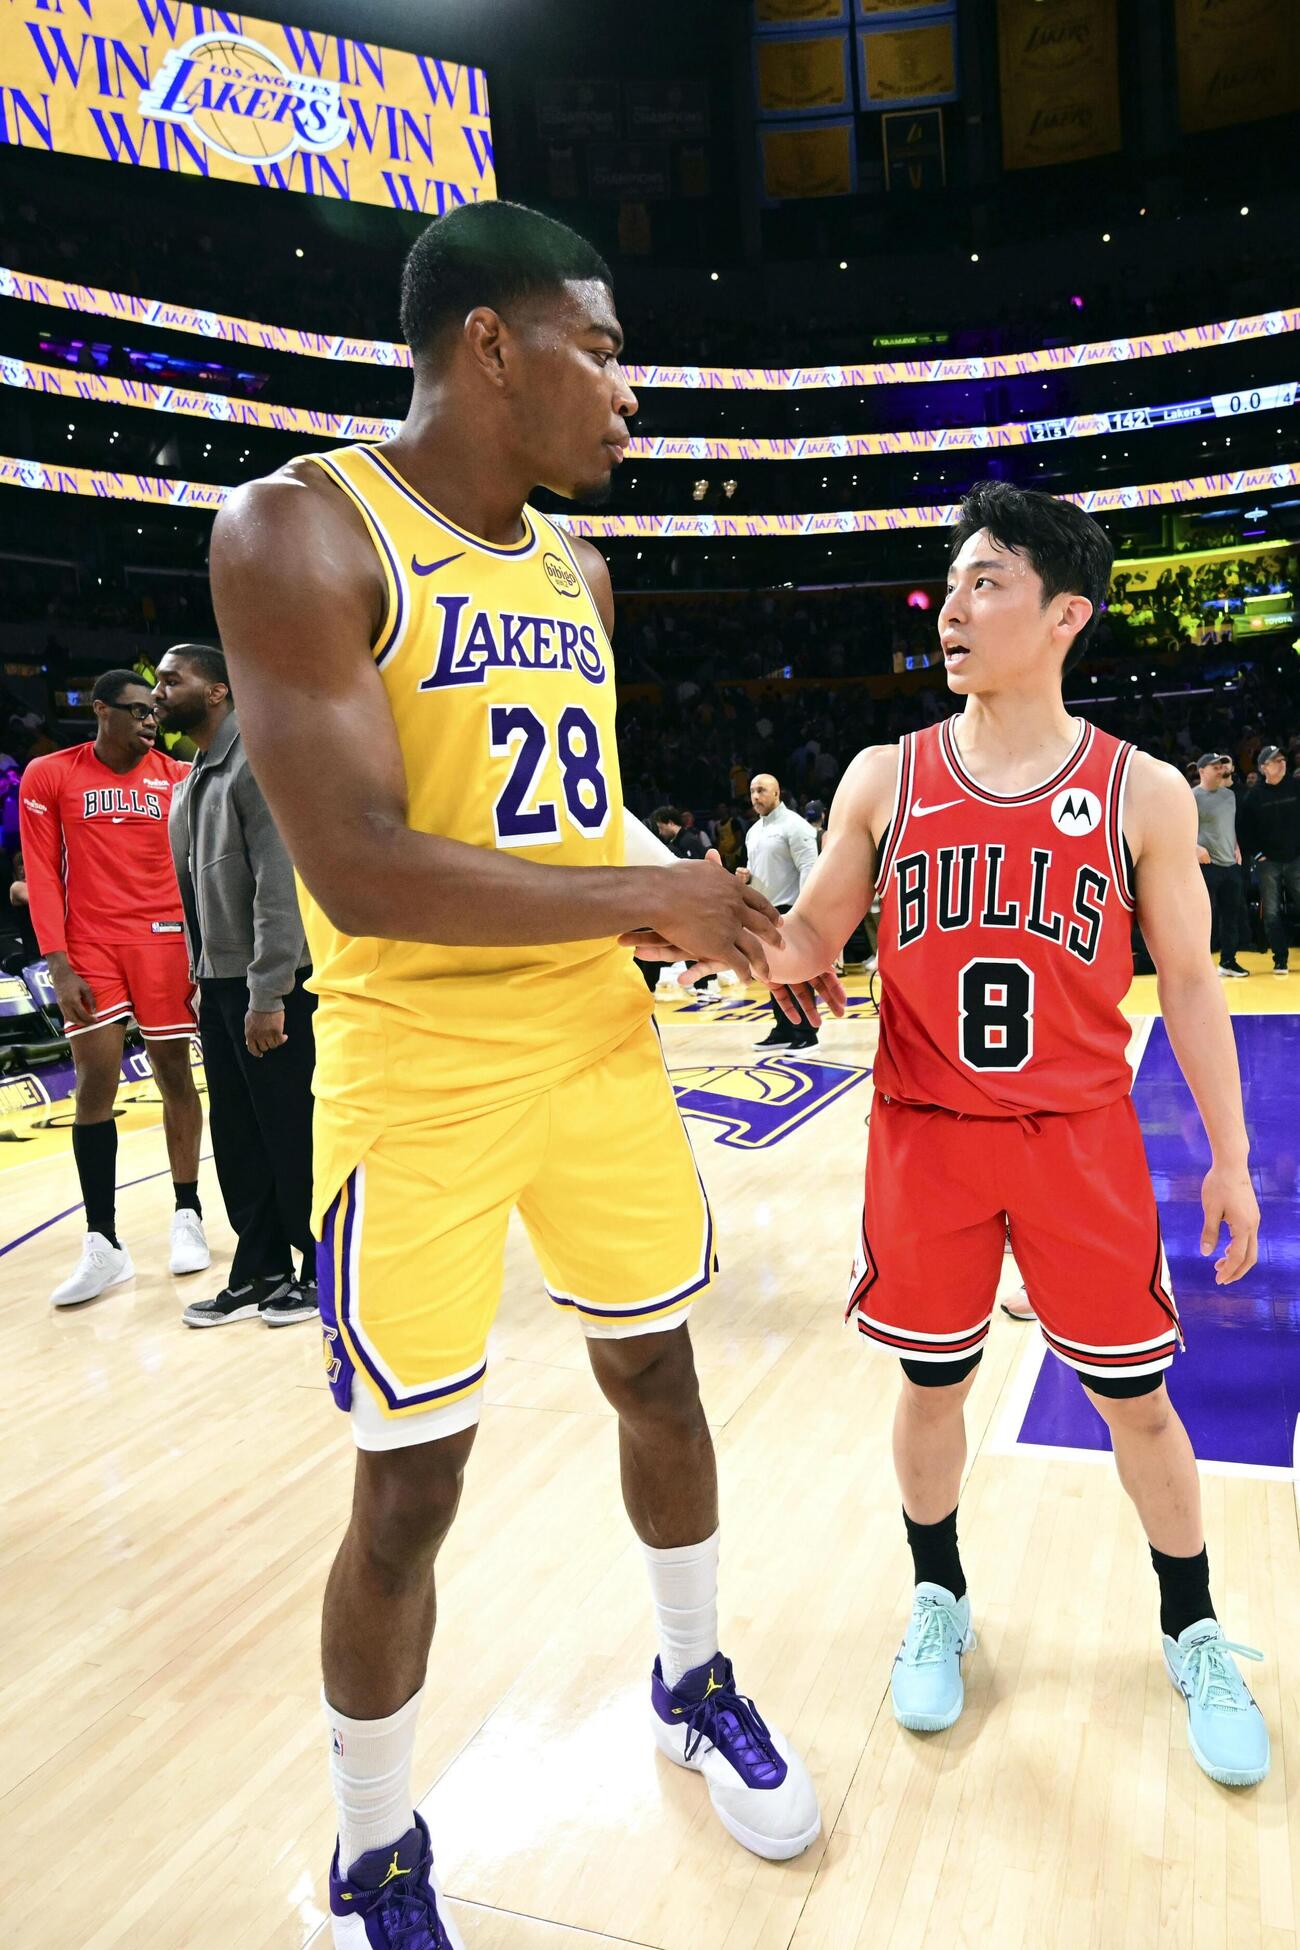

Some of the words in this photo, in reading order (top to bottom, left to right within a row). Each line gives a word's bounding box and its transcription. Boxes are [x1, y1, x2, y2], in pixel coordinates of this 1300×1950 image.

[24, 21, 151, 99] WIN
[338, 95, 434, 166] WIN
[151, 56, 341, 144] LAKERS
[209, 64, 243, 79] LOS
[247, 72, 331, 96] ANGELES
[282, 25, 385, 92] WIN
[416, 54, 490, 118] WI
[88, 107, 209, 176] WIN
[1037, 429, 1045, 439] 2
[1053, 427, 1062, 437] 5
[1113, 411, 1146, 430] 142
[1163, 408, 1201, 421] Lakers
[1230, 392, 1261, 413] 0.0
[1283, 392, 1291, 404] 4
[177, 485, 229, 504] LAKER
[545, 562, 576, 586] bibigo
[418, 594, 606, 692] LAKERS
[83, 788, 162, 820] BULLS
[489, 703, 612, 849] 28
[894, 844, 1110, 966] BULLS
[958, 957, 1035, 1073] 8
